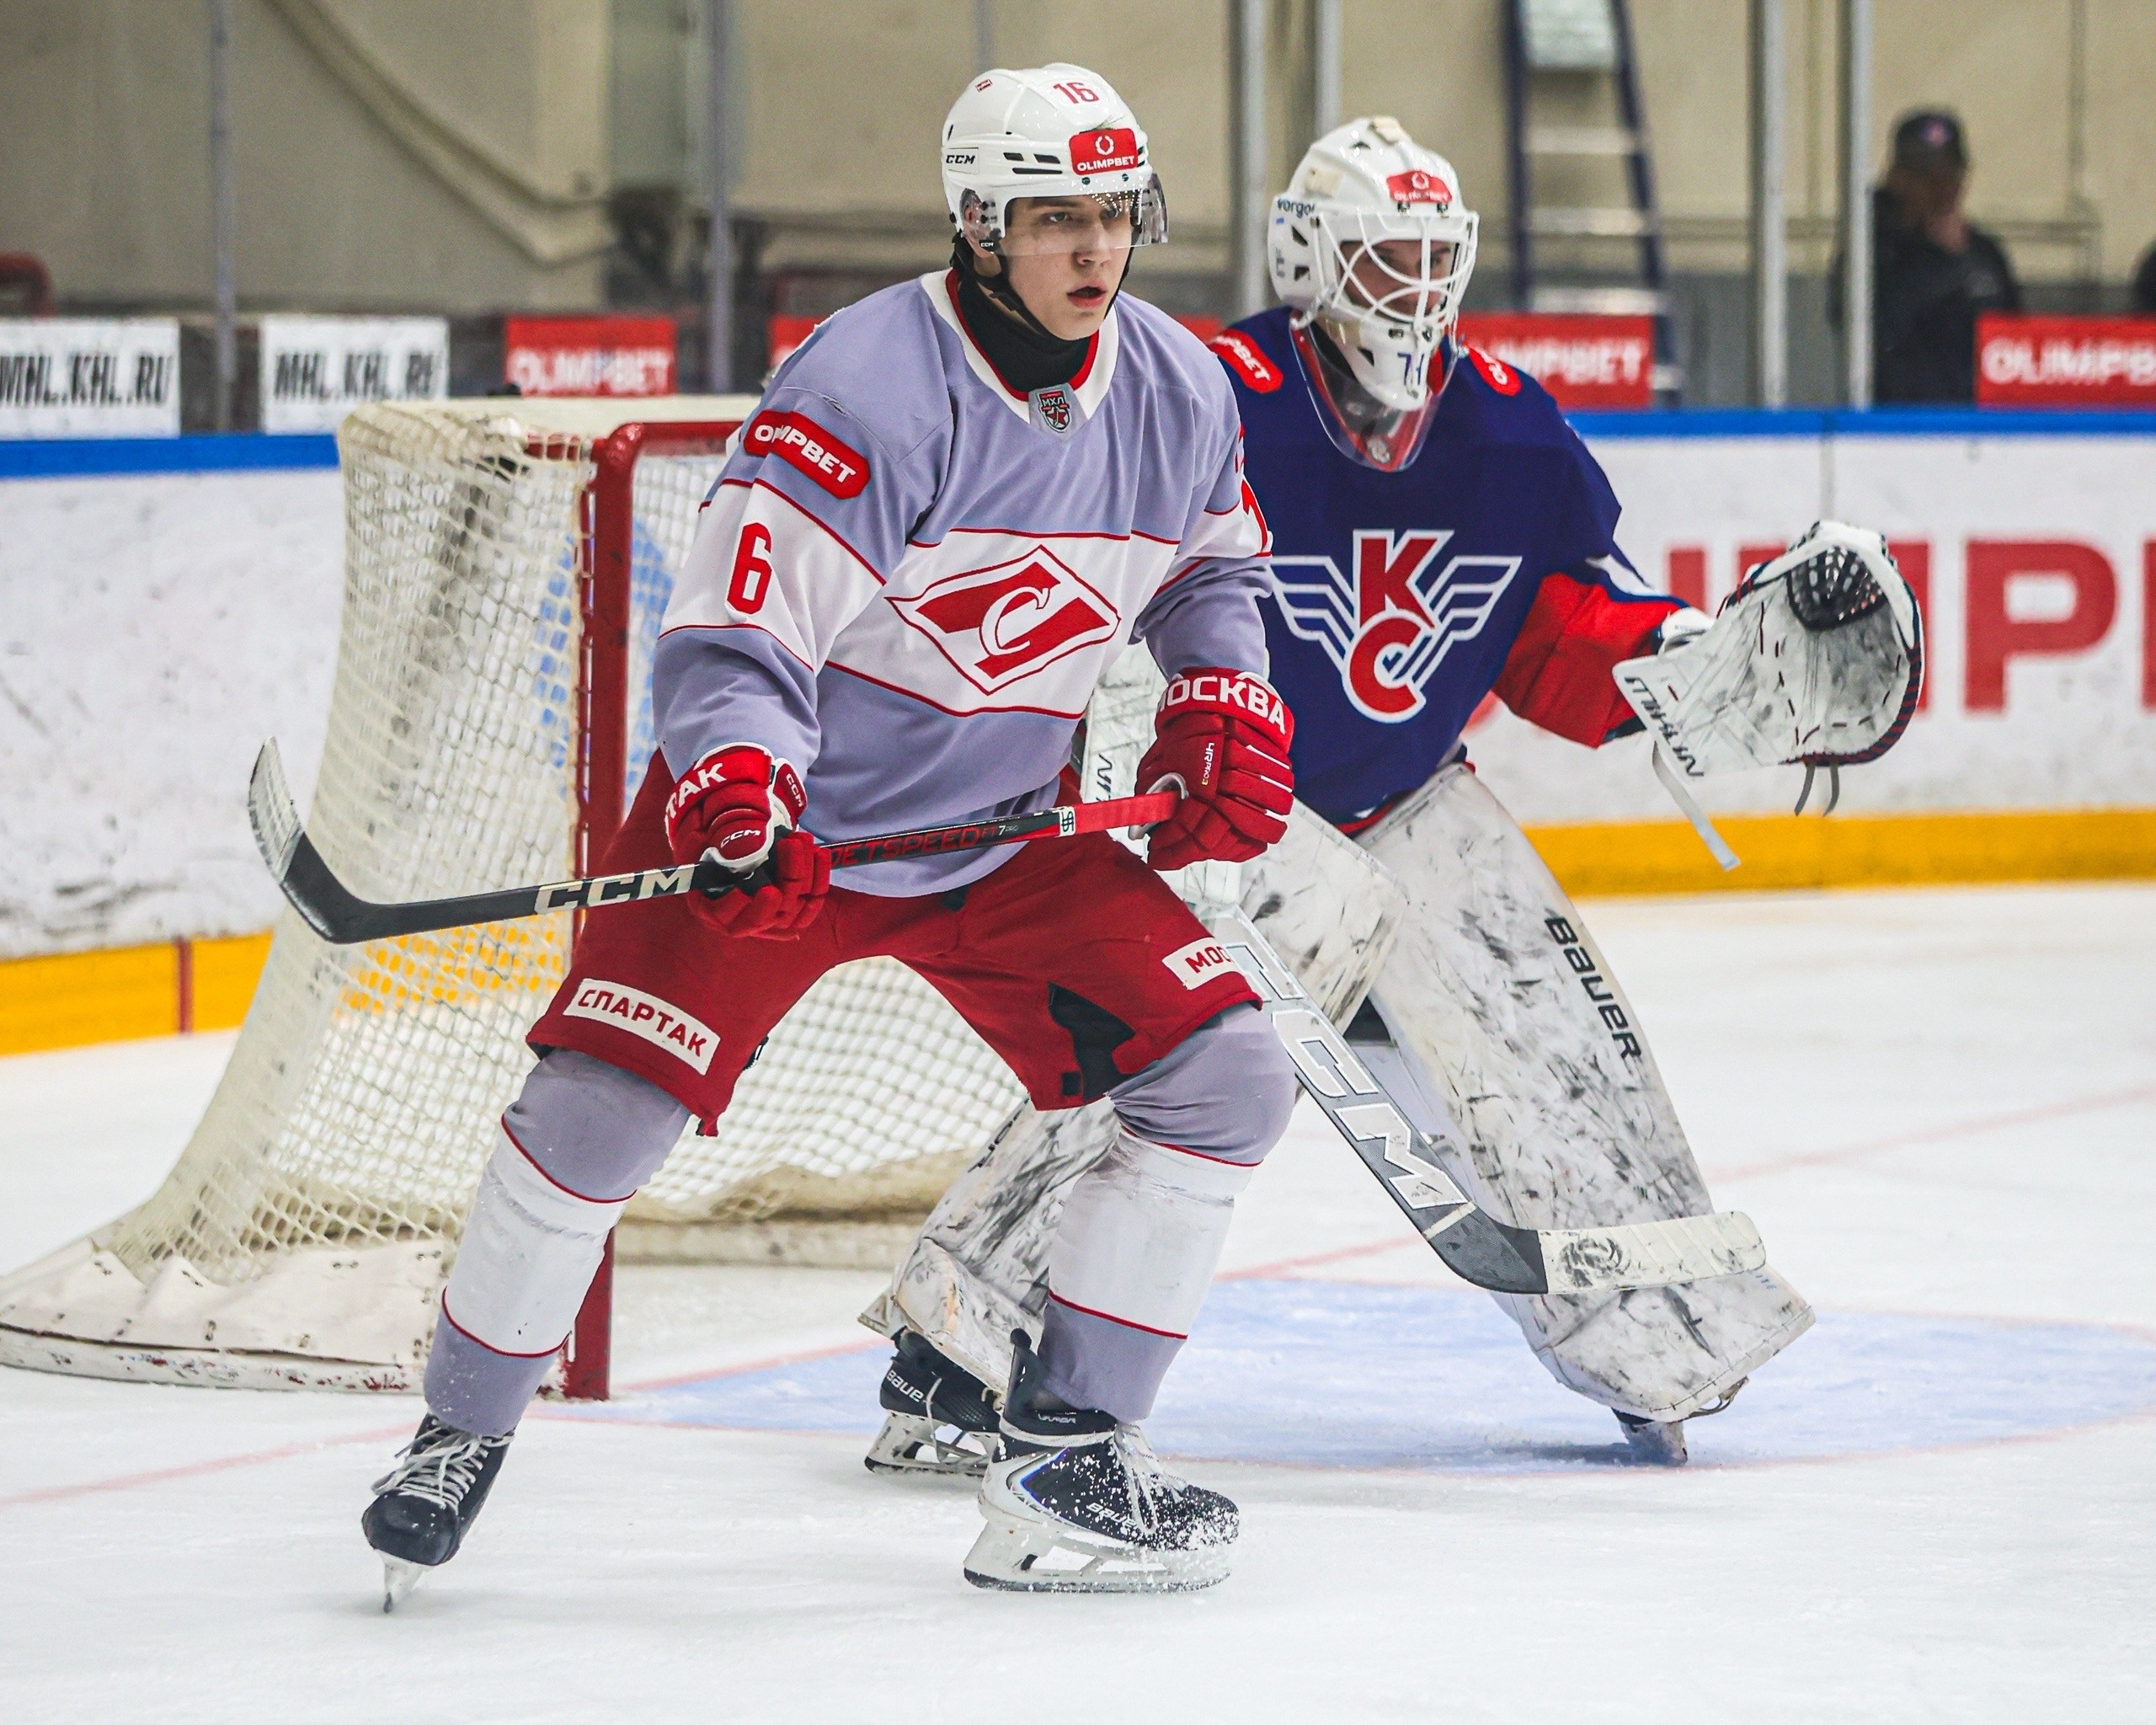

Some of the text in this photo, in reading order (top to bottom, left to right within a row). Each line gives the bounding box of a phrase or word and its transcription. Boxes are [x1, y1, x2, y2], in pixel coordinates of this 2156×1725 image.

[1053, 82, 1100, 104] 16
[945, 154, 975, 164] CCM
[1076, 155, 1135, 172] OLIMPBET
[786, 773, 804, 808] CCM
[720, 829, 761, 849] CCM
[533, 864, 696, 915] CCM
[577, 989, 707, 1058] СПАРТАК
